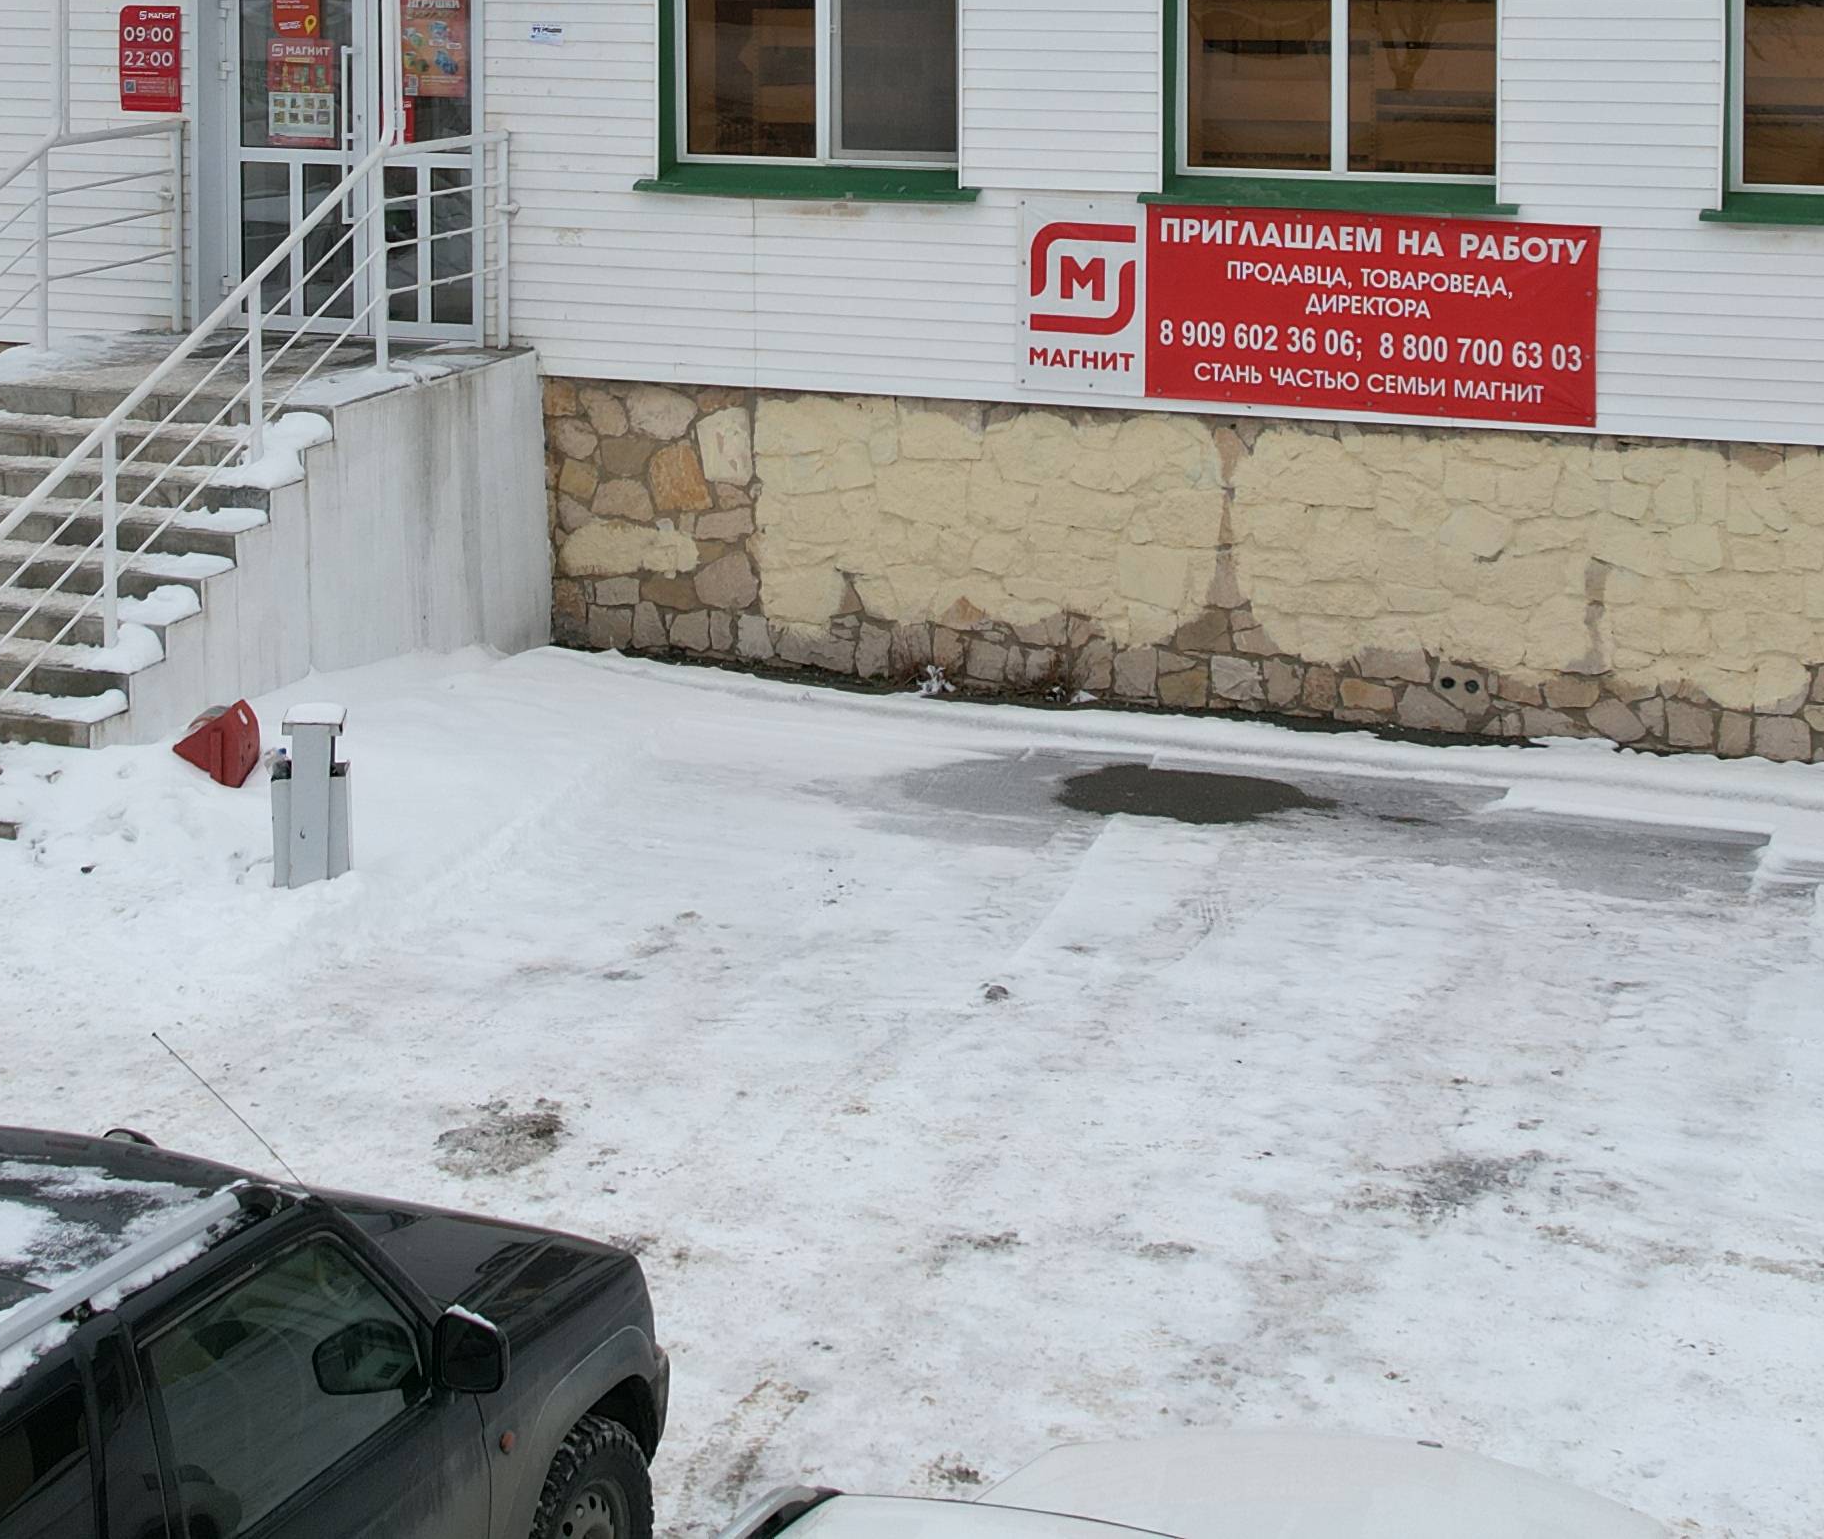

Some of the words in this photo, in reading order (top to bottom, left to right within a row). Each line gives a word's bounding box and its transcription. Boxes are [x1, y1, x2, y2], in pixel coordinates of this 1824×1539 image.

[123, 26, 174, 42] 09:00
[123, 51, 173, 67] 22:00
[285, 45, 331, 56] МАГНИТ
[1160, 217, 1382, 254] ПРИГЛАШАЕМ
[1397, 229, 1445, 257] НА
[1459, 233, 1588, 264] РАБОТУ
[1226, 261, 1353, 290] ПРОДАВЦА,
[1360, 268, 1514, 299] ТОВАРОВЕДА,
[1305, 293, 1432, 319] ДИРЕКТОРА
[1159, 319, 1174, 345] 8
[1181, 320, 1226, 348] 909
[1233, 322, 1279, 351] 602
[1286, 326, 1317, 355] 36
[1324, 328, 1363, 361] 06;
[1379, 332, 1395, 359] 8
[1402, 334, 1449, 363] 800
[1456, 337, 1504, 367] 700
[1511, 341, 1543, 370] 63
[1551, 343, 1583, 372] 03
[1029, 347, 1135, 372] МАГНИТ
[1194, 362, 1263, 384] СТАНЬ
[1269, 366, 1360, 391] ЧАСТЬЮ
[1367, 372, 1447, 397] СЕМЬИ
[1454, 379, 1545, 404] МАГНИТ
